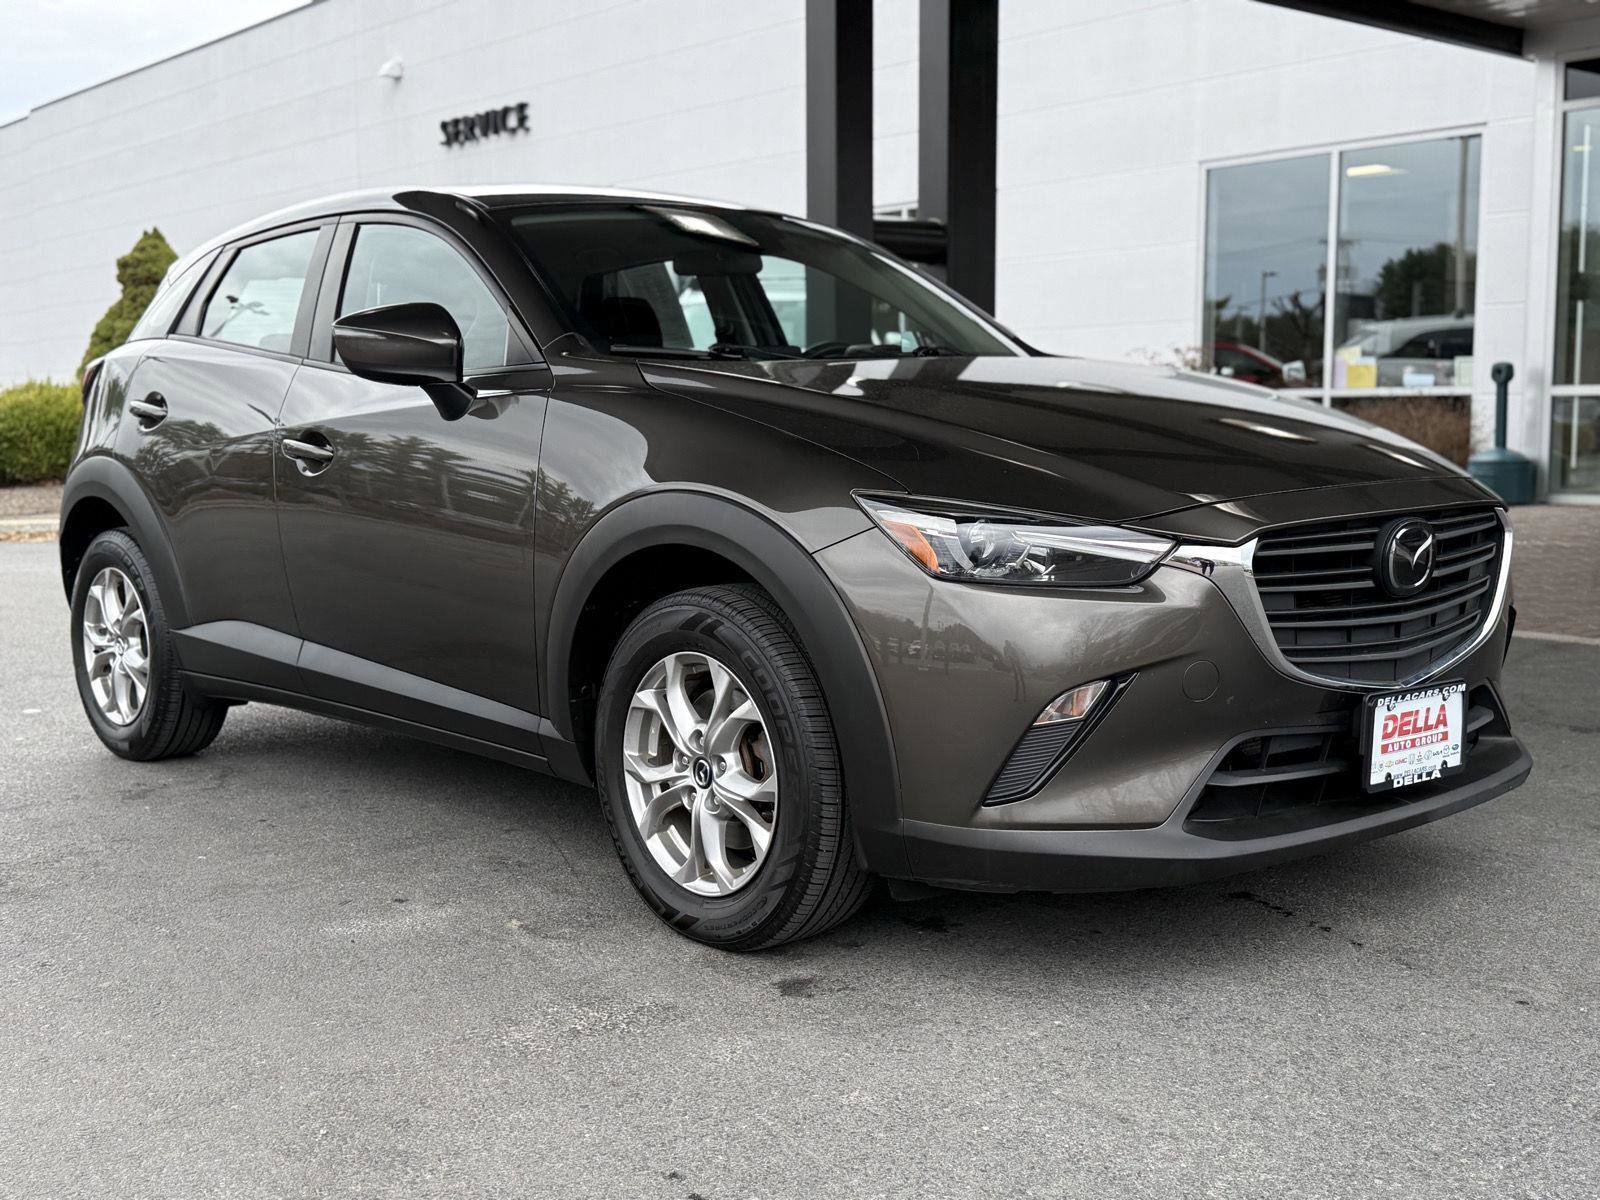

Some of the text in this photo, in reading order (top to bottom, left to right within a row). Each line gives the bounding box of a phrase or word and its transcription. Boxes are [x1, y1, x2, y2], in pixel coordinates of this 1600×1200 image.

[440, 102, 530, 147] SERVICE
[1377, 684, 1466, 706] DELLACARS.COM
[1382, 704, 1448, 739] DELLA
[1387, 733, 1443, 753] AUTO GROUP
[1393, 769, 1441, 788] DELLA
